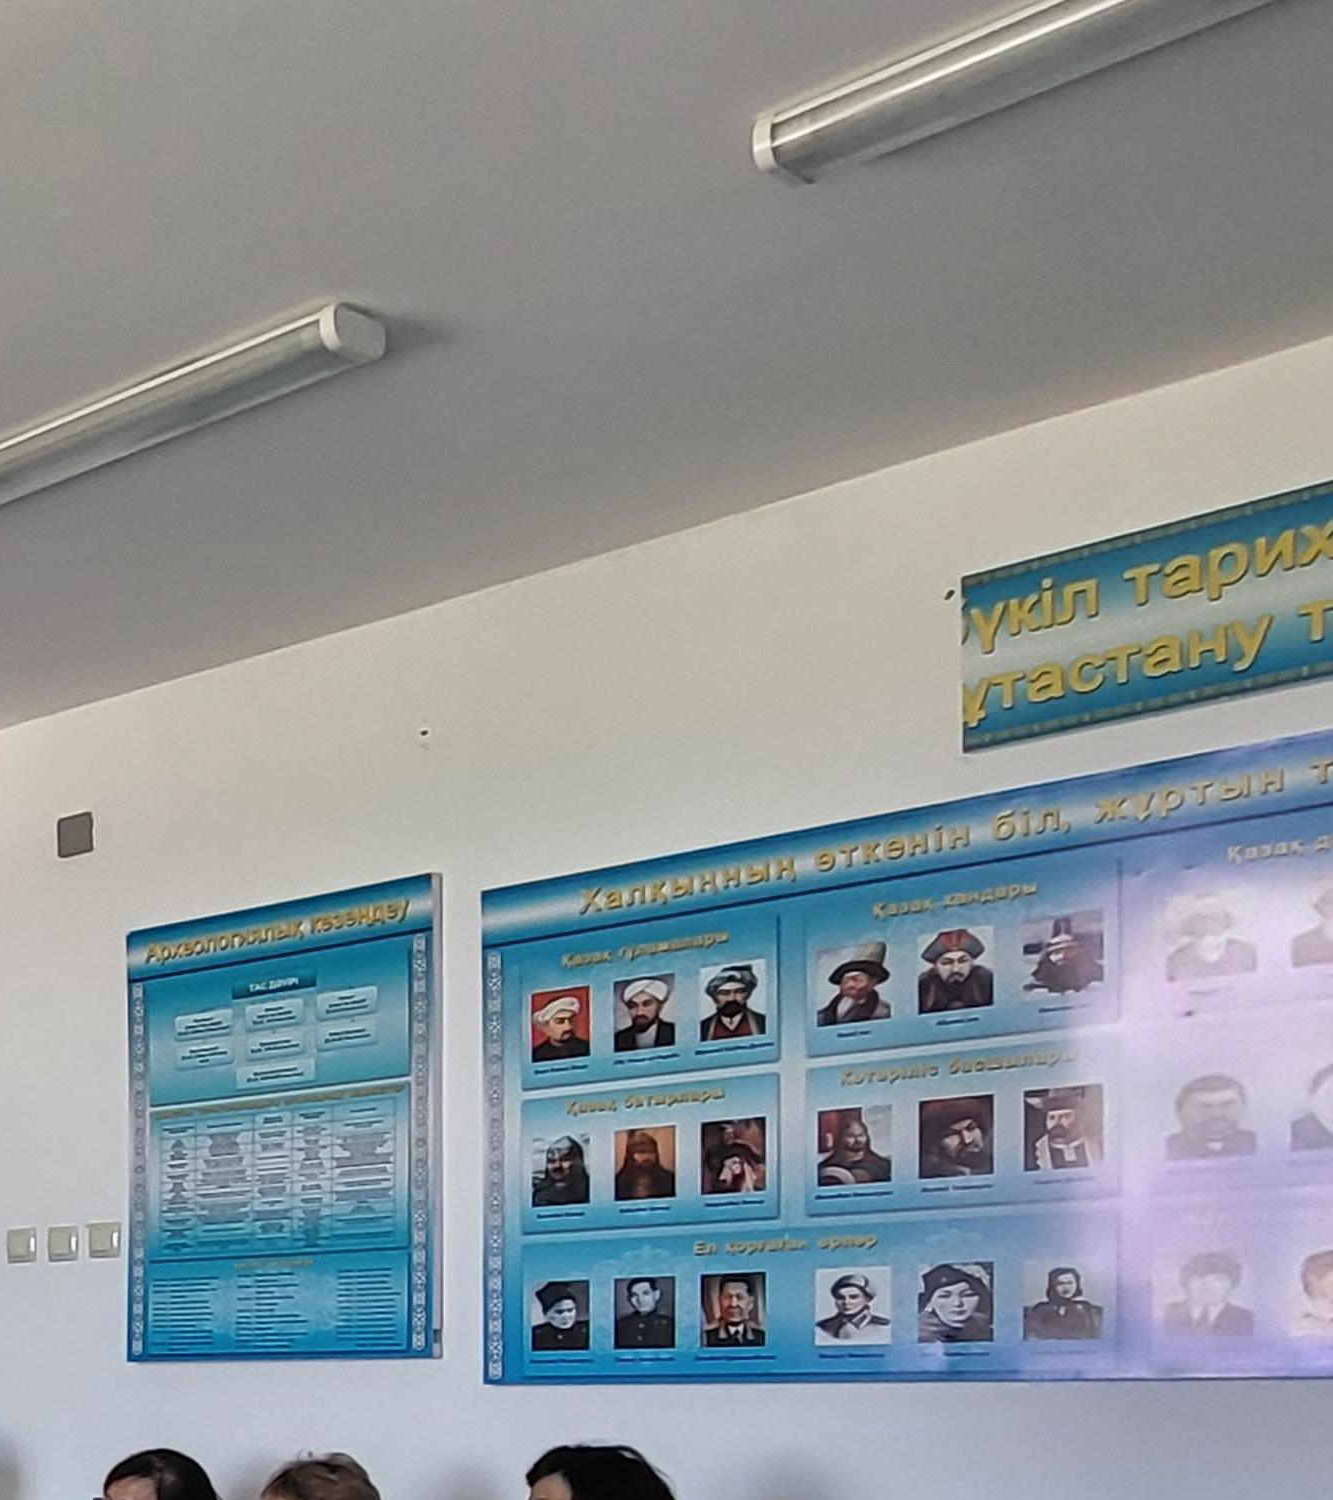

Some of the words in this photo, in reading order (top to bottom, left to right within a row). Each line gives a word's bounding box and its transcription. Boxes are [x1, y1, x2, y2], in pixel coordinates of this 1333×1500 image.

[991, 808, 1071, 841] біл,
[1094, 768, 1284, 823] жұртын
[873, 898, 934, 919] Қазақ
